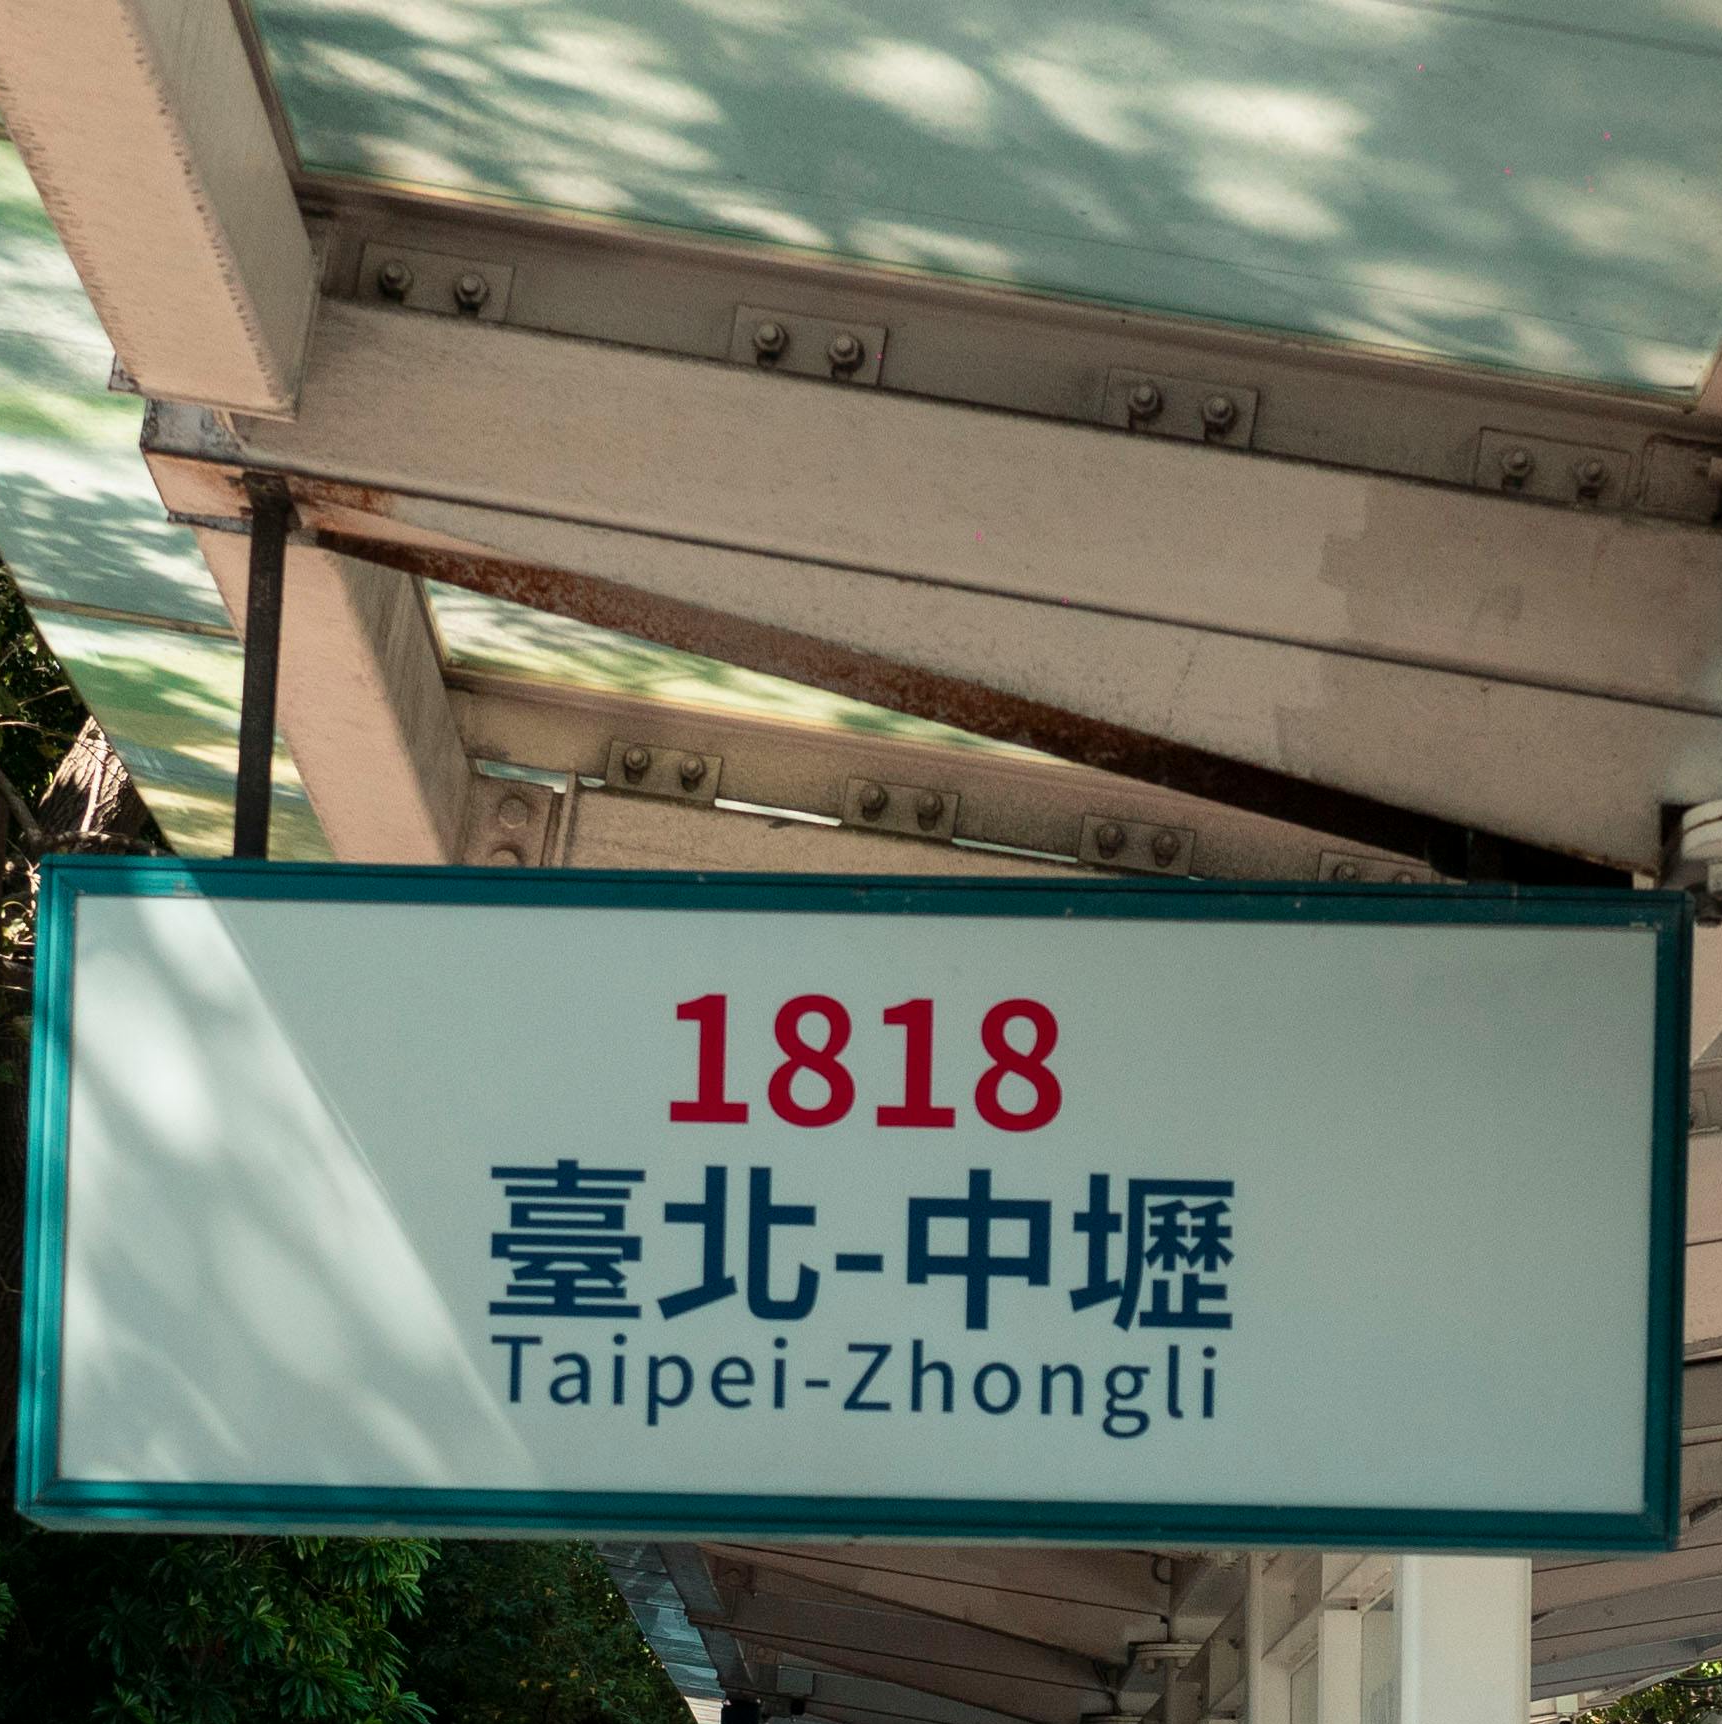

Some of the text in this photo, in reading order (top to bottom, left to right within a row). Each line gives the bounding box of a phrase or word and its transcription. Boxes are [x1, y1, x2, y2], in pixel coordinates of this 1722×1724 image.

[670, 994, 1062, 1132] 1818
[488, 1158, 1235, 1333] 臺北-中壢
[490, 1333, 1217, 1441] Taipei-Zhongli
